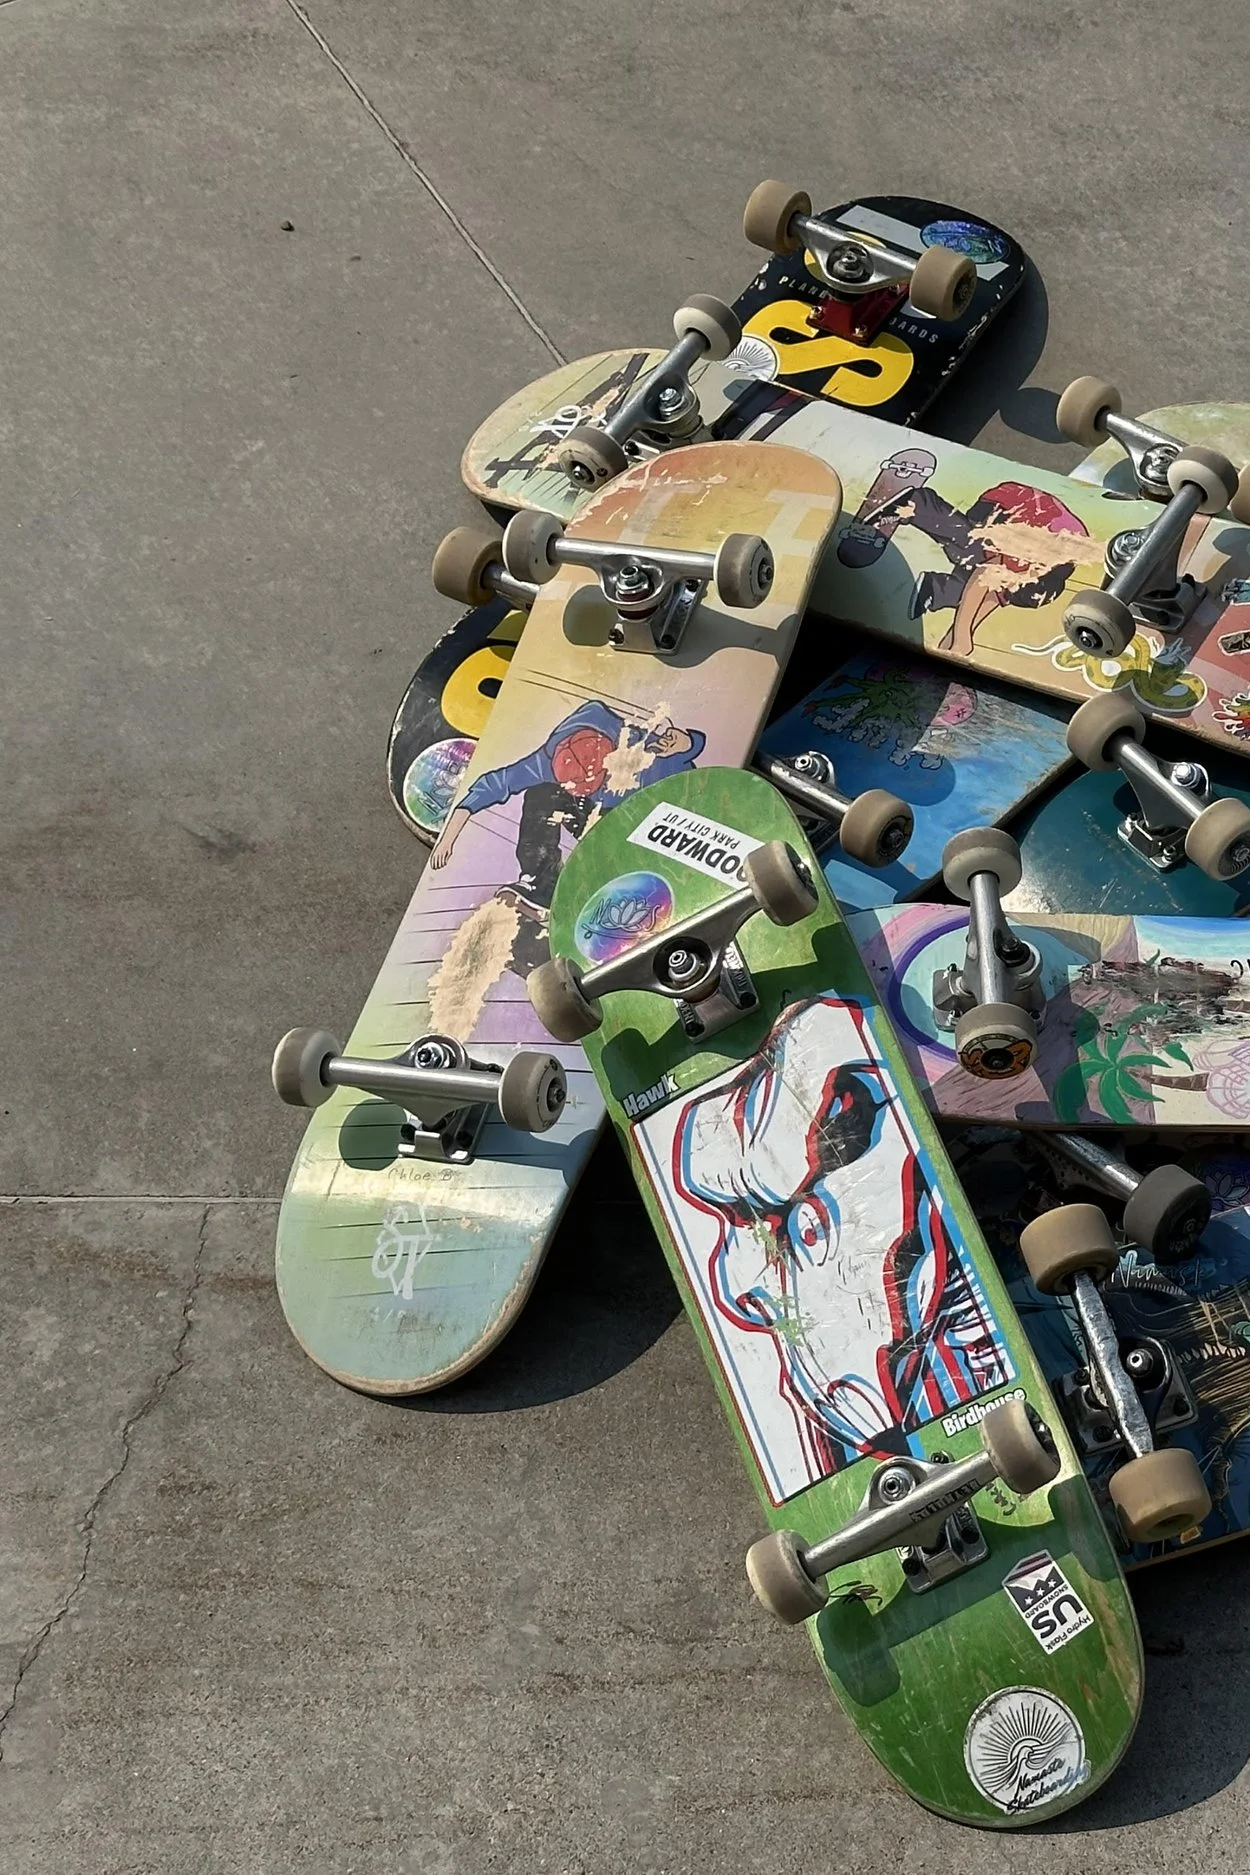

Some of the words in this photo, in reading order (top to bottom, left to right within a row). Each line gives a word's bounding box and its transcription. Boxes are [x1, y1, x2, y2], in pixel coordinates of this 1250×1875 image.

[662, 812, 679, 824] UT
[683, 820, 711, 836] CITY
[709, 830, 741, 849] PARK
[622, 1073, 680, 1119] Hawk
[1025, 1585, 1069, 1619] SNOWBOARD
[1031, 1593, 1083, 1639] US
[1066, 1615, 1091, 1634] Hydro
[1045, 1631, 1068, 1651] Flask
